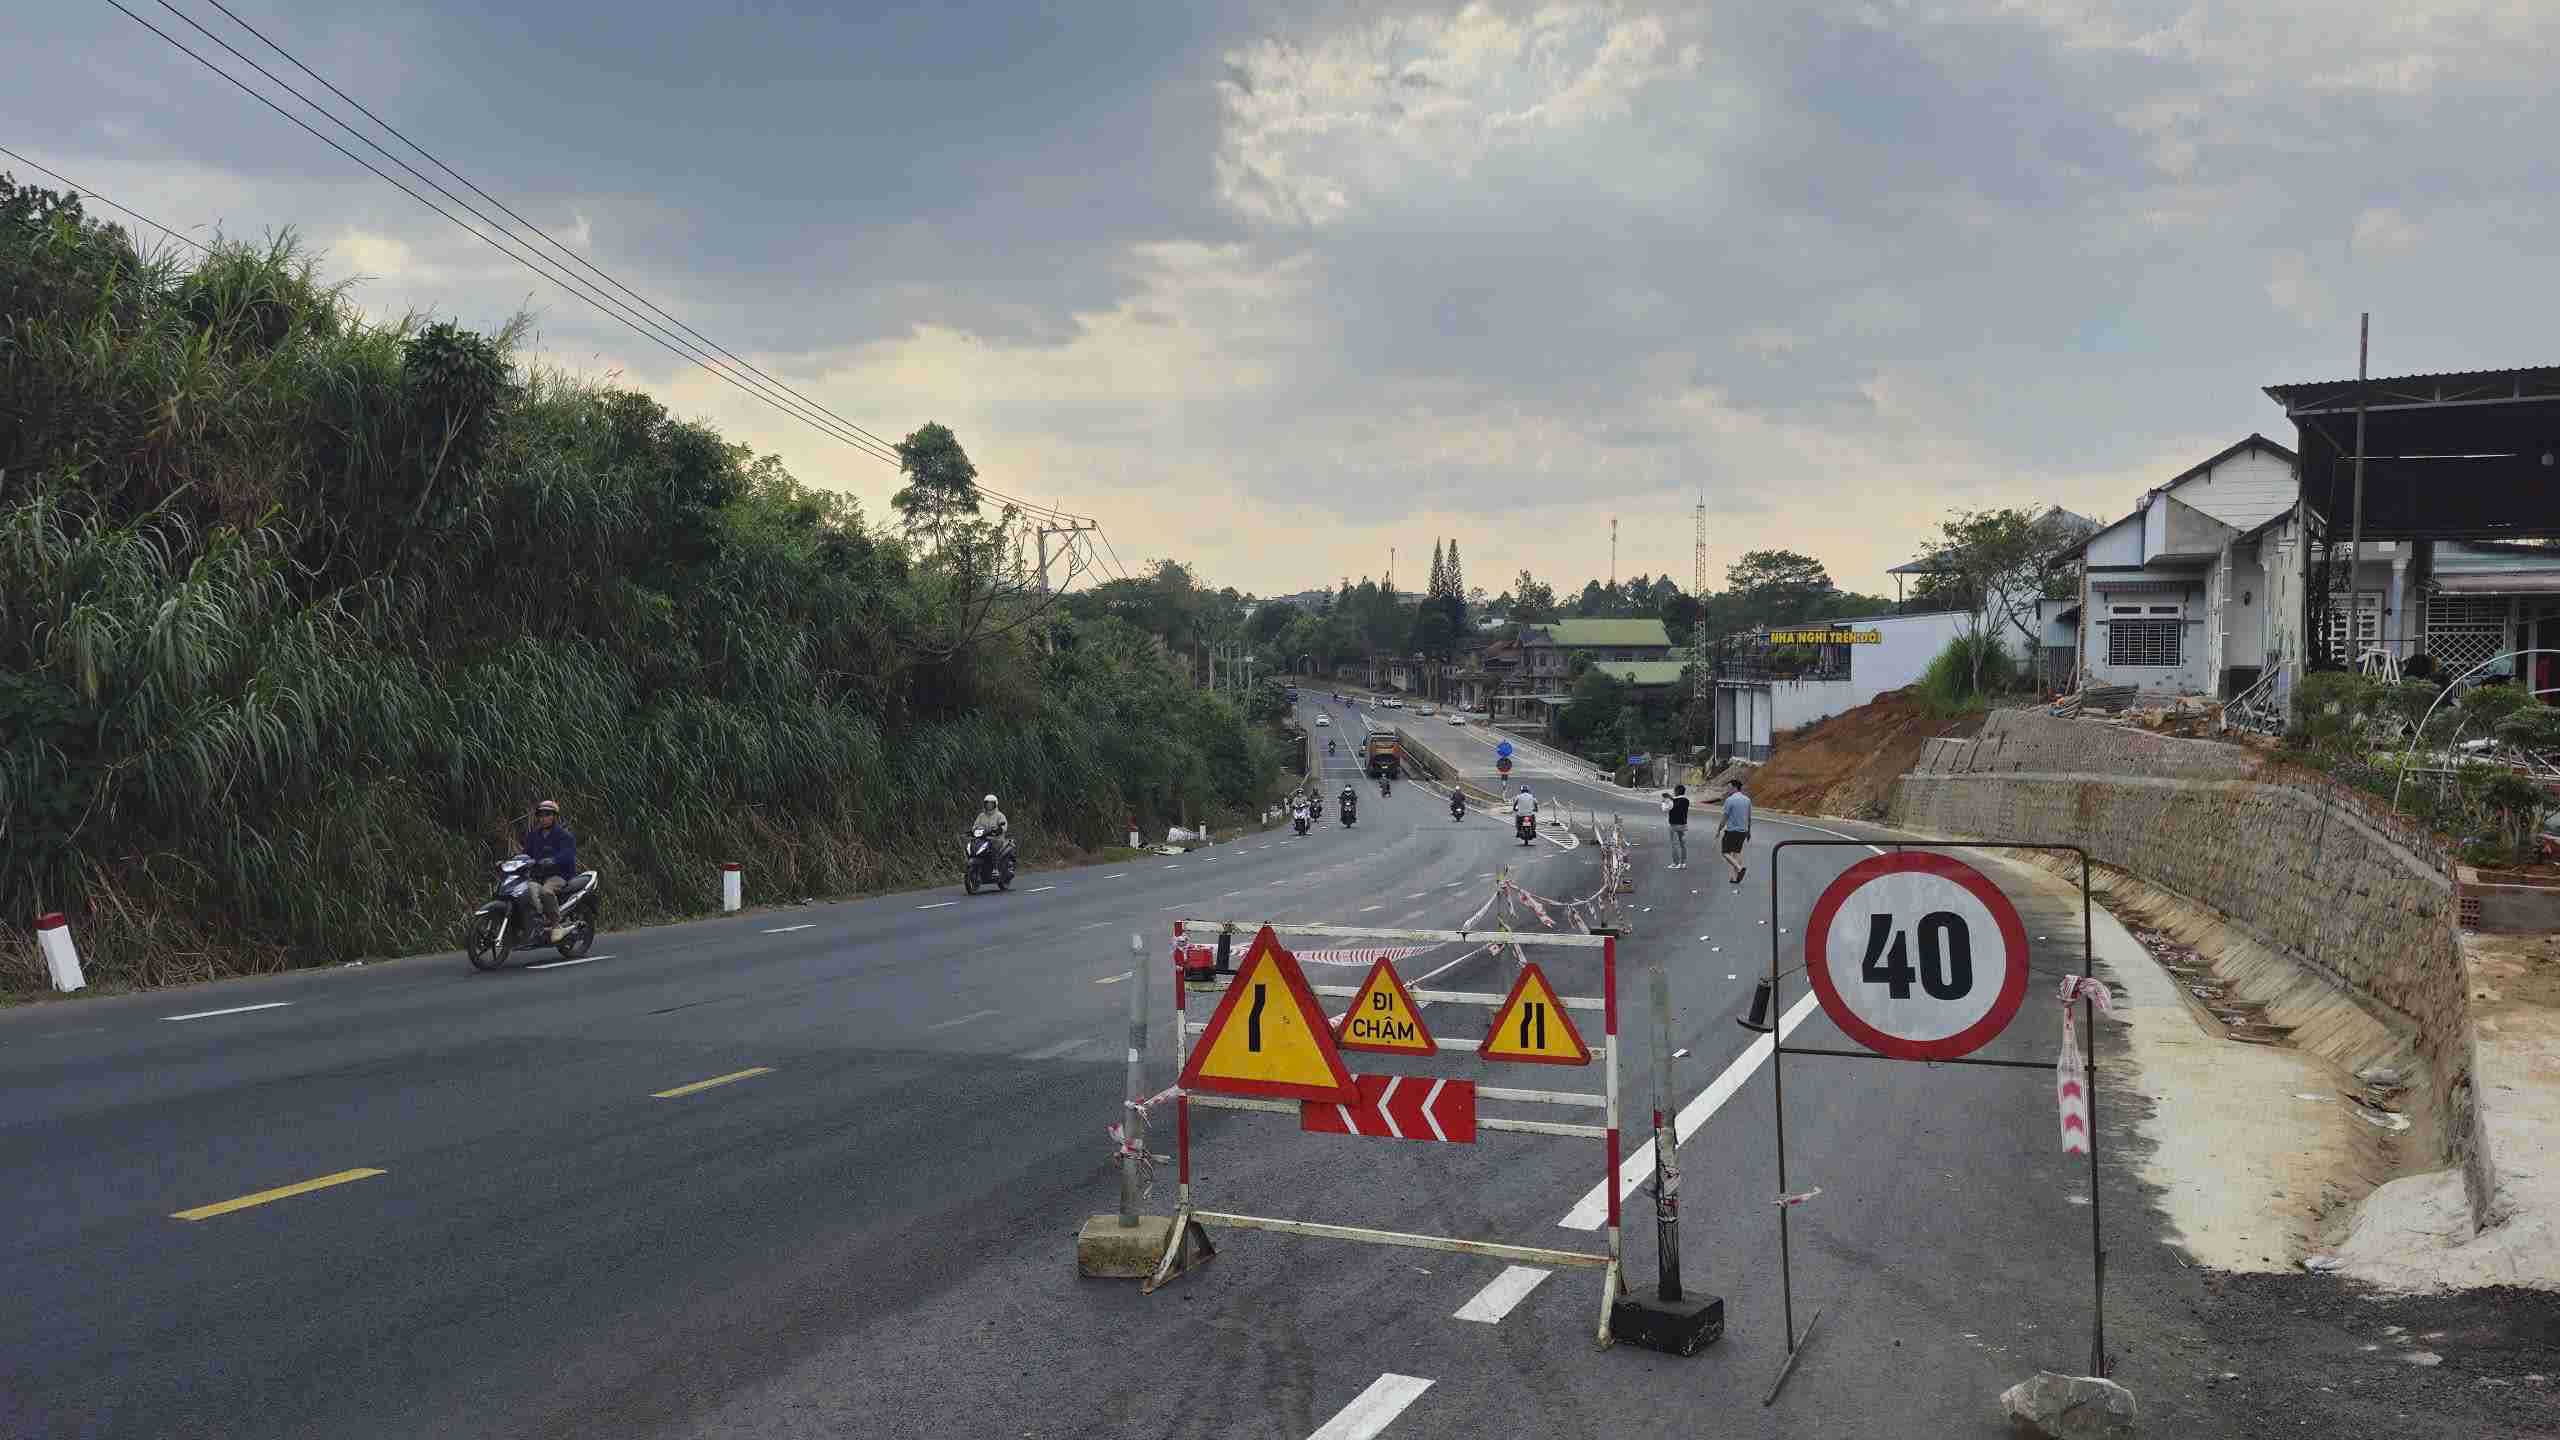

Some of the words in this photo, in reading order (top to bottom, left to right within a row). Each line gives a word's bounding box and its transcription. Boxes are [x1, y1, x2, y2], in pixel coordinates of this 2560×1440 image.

[1862, 910, 1973, 1001] 40
[1373, 992, 1393, 1011] ĐI
[1353, 1016, 1414, 1044] CHẬM
